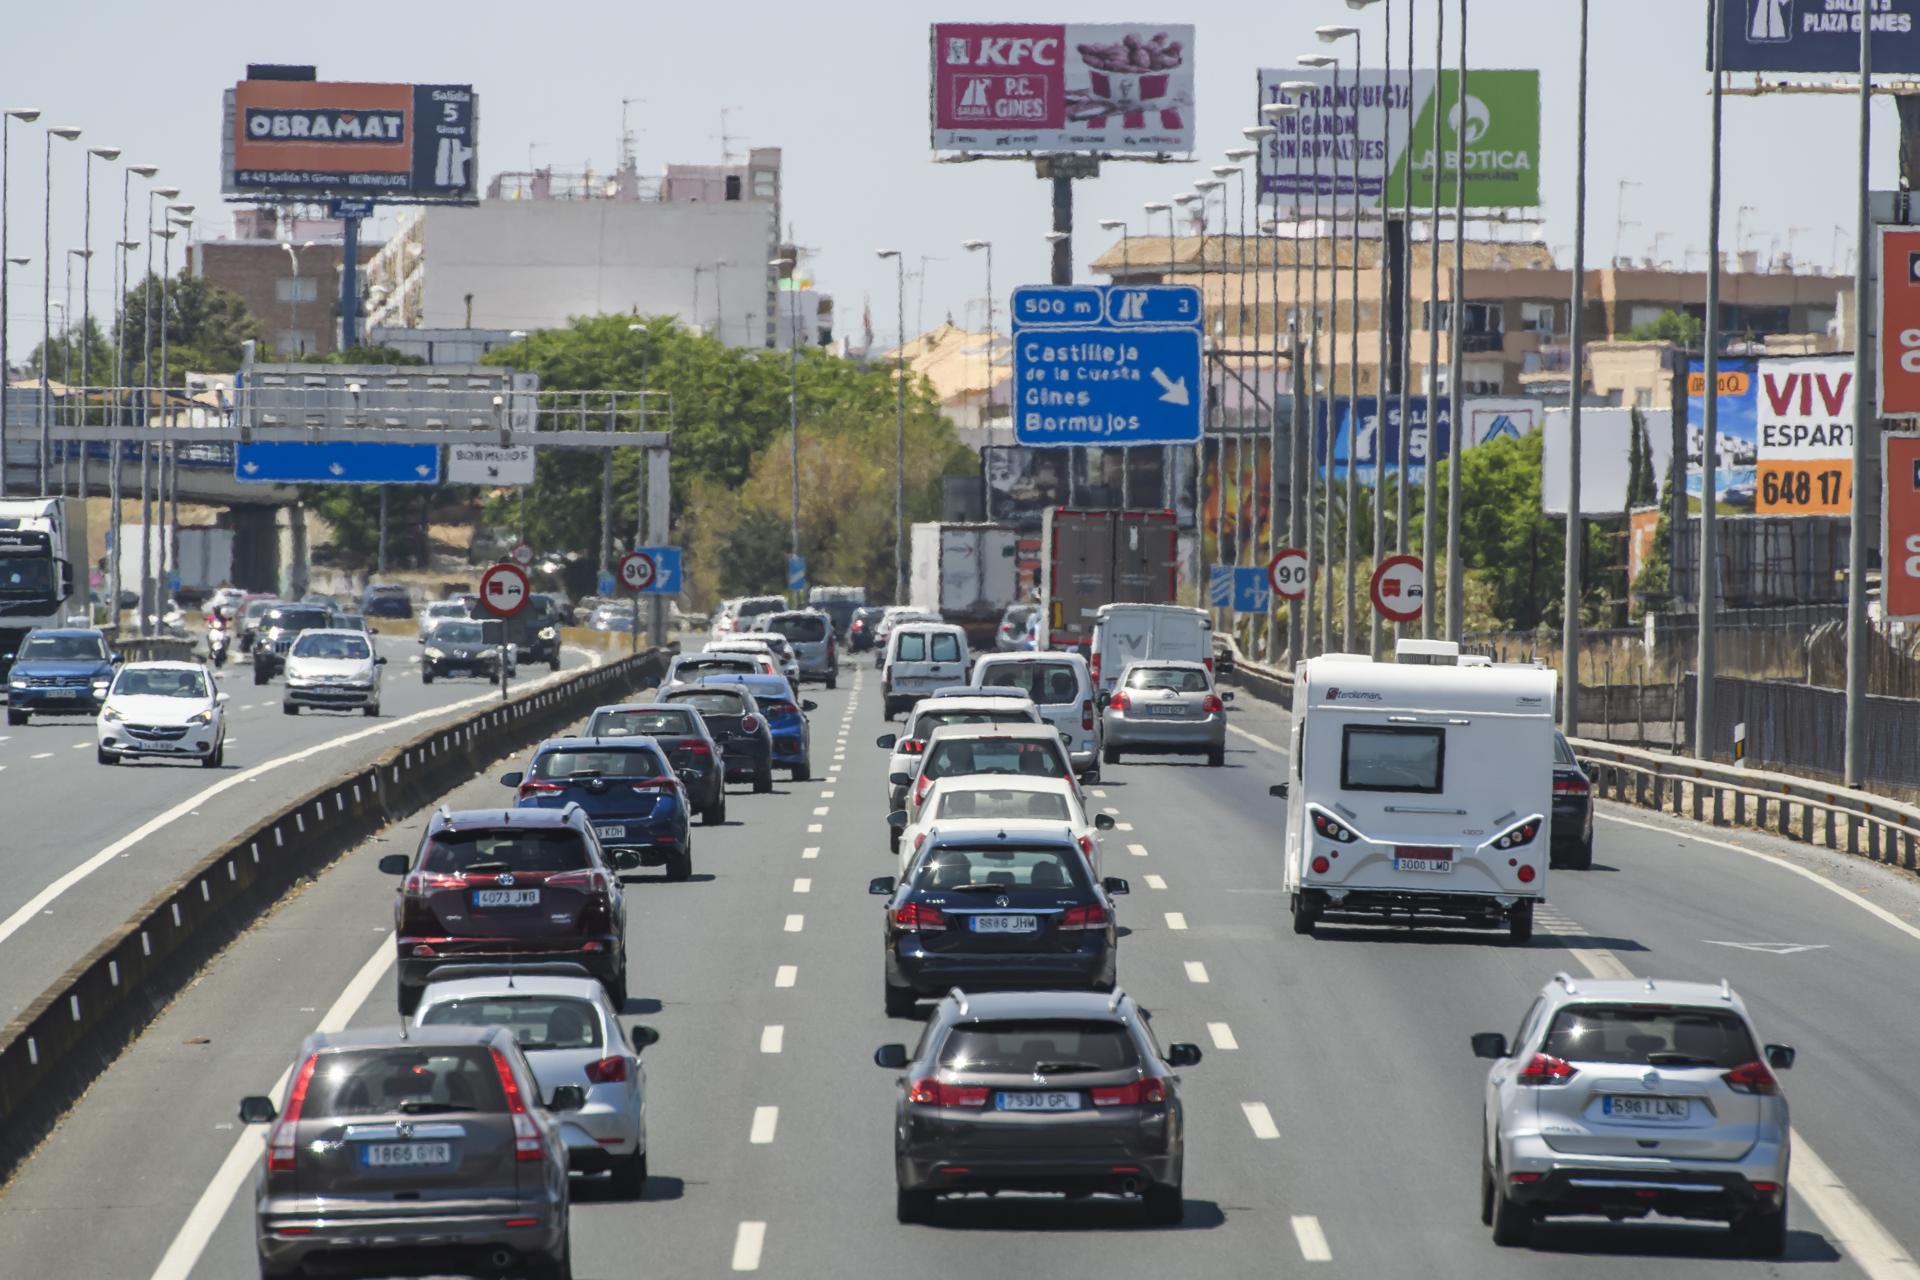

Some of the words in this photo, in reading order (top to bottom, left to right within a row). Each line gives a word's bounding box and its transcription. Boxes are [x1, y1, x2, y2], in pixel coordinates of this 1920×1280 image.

[1803, 13, 1848, 33] PLAZA
[1850, 12, 1912, 33] GNES
[976, 38, 1058, 65] KFC
[1005, 77, 1034, 95] P.C.
[431, 90, 470, 102] Salida
[443, 102, 459, 122] 5
[995, 98, 1043, 117] GINES
[249, 114, 401, 138] OBRAMAT
[1269, 140, 1296, 159] SIN
[1444, 149, 1531, 170] BOTICA
[1025, 298, 1065, 314] 500
[1074, 300, 1091, 314] m
[1178, 299, 1190, 313] 3
[1024, 342, 1139, 366] Castilleja
[1025, 366, 1046, 381] de
[1054, 366, 1070, 382] la
[1076, 366, 1141, 381] Cuesta
[1726, 375, 1743, 392] Q
[1026, 387, 1091, 407] Gines
[1763, 372, 1853, 417] VIV
[1025, 412, 1141, 436] Bormujos
[1409, 428, 1430, 459] 5
[1762, 470, 1811, 506] 648
[1817, 470, 1842, 505] 17
[625, 563, 649, 579] 90
[1279, 565, 1306, 584] 90
[1400, 859, 1427, 871] 3000
[1429, 860, 1450, 872] LMD
[482, 891, 511, 905] 4073
[1012, 917, 1035, 929] JHM
[1047, 1094, 1073, 1108] GPL
[1613, 1099, 1650, 1114] 5961
